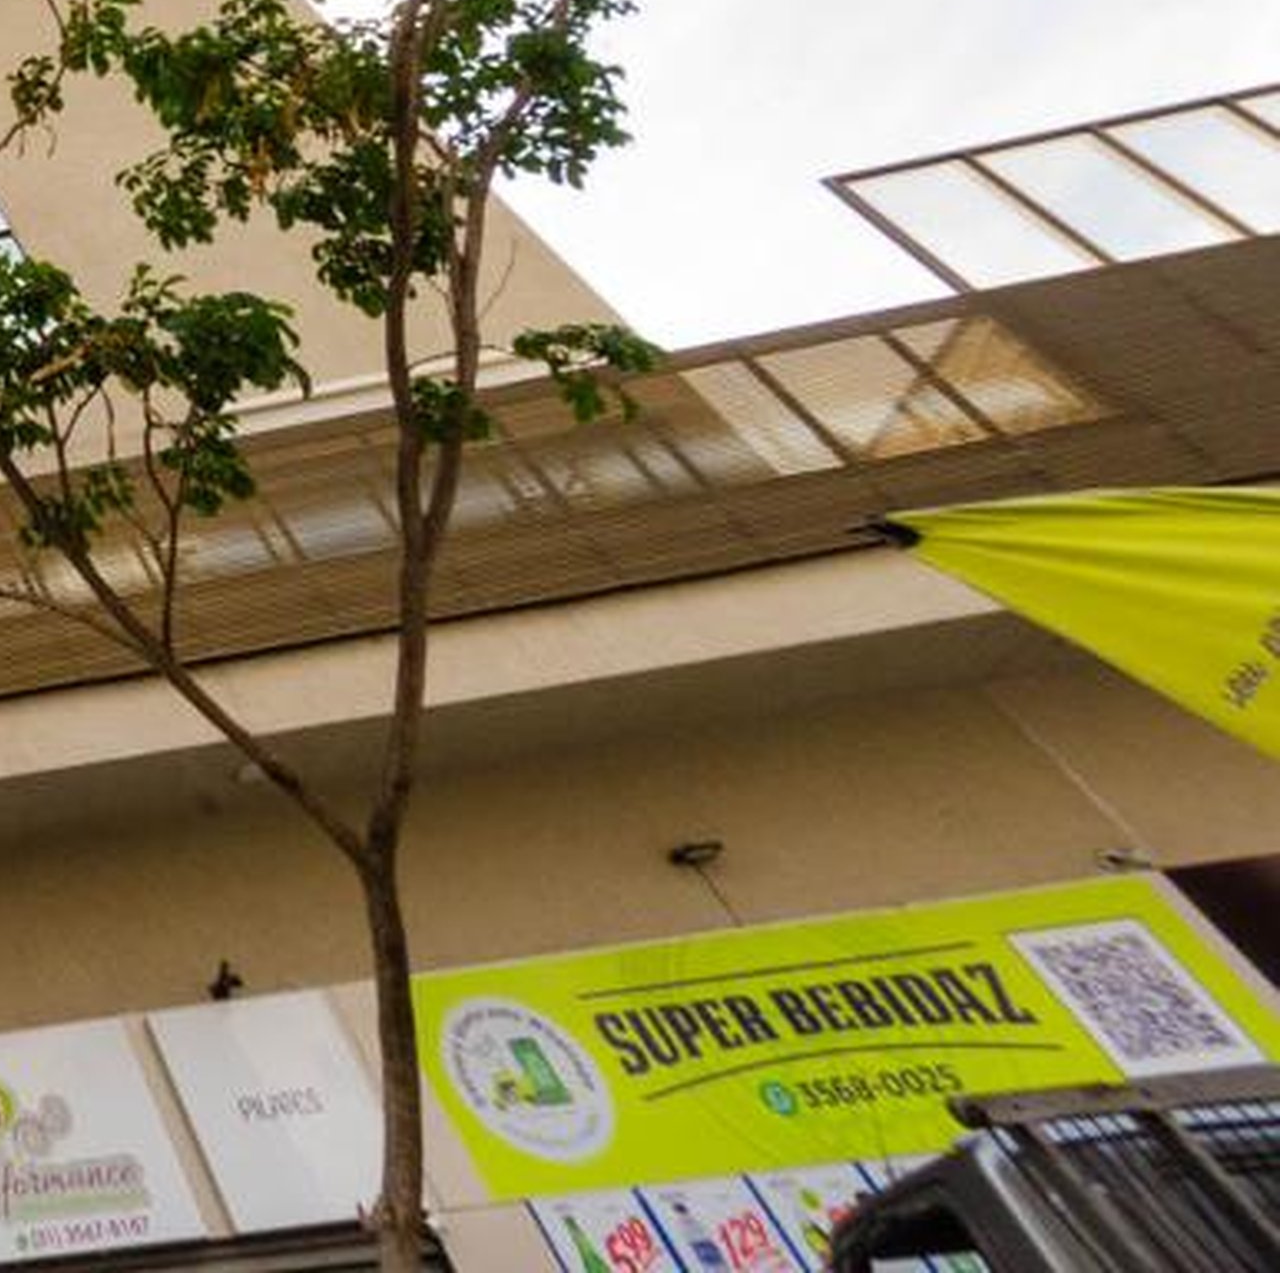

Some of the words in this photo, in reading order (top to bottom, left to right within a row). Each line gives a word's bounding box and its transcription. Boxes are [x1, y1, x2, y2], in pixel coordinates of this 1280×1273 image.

[594, 993, 780, 1076] SUPER
[769, 962, 1038, 1037] BEBIDAZ
[236, 1088, 324, 1122] PILATES
[796, 1064, 965, 1109] 3568-0025
